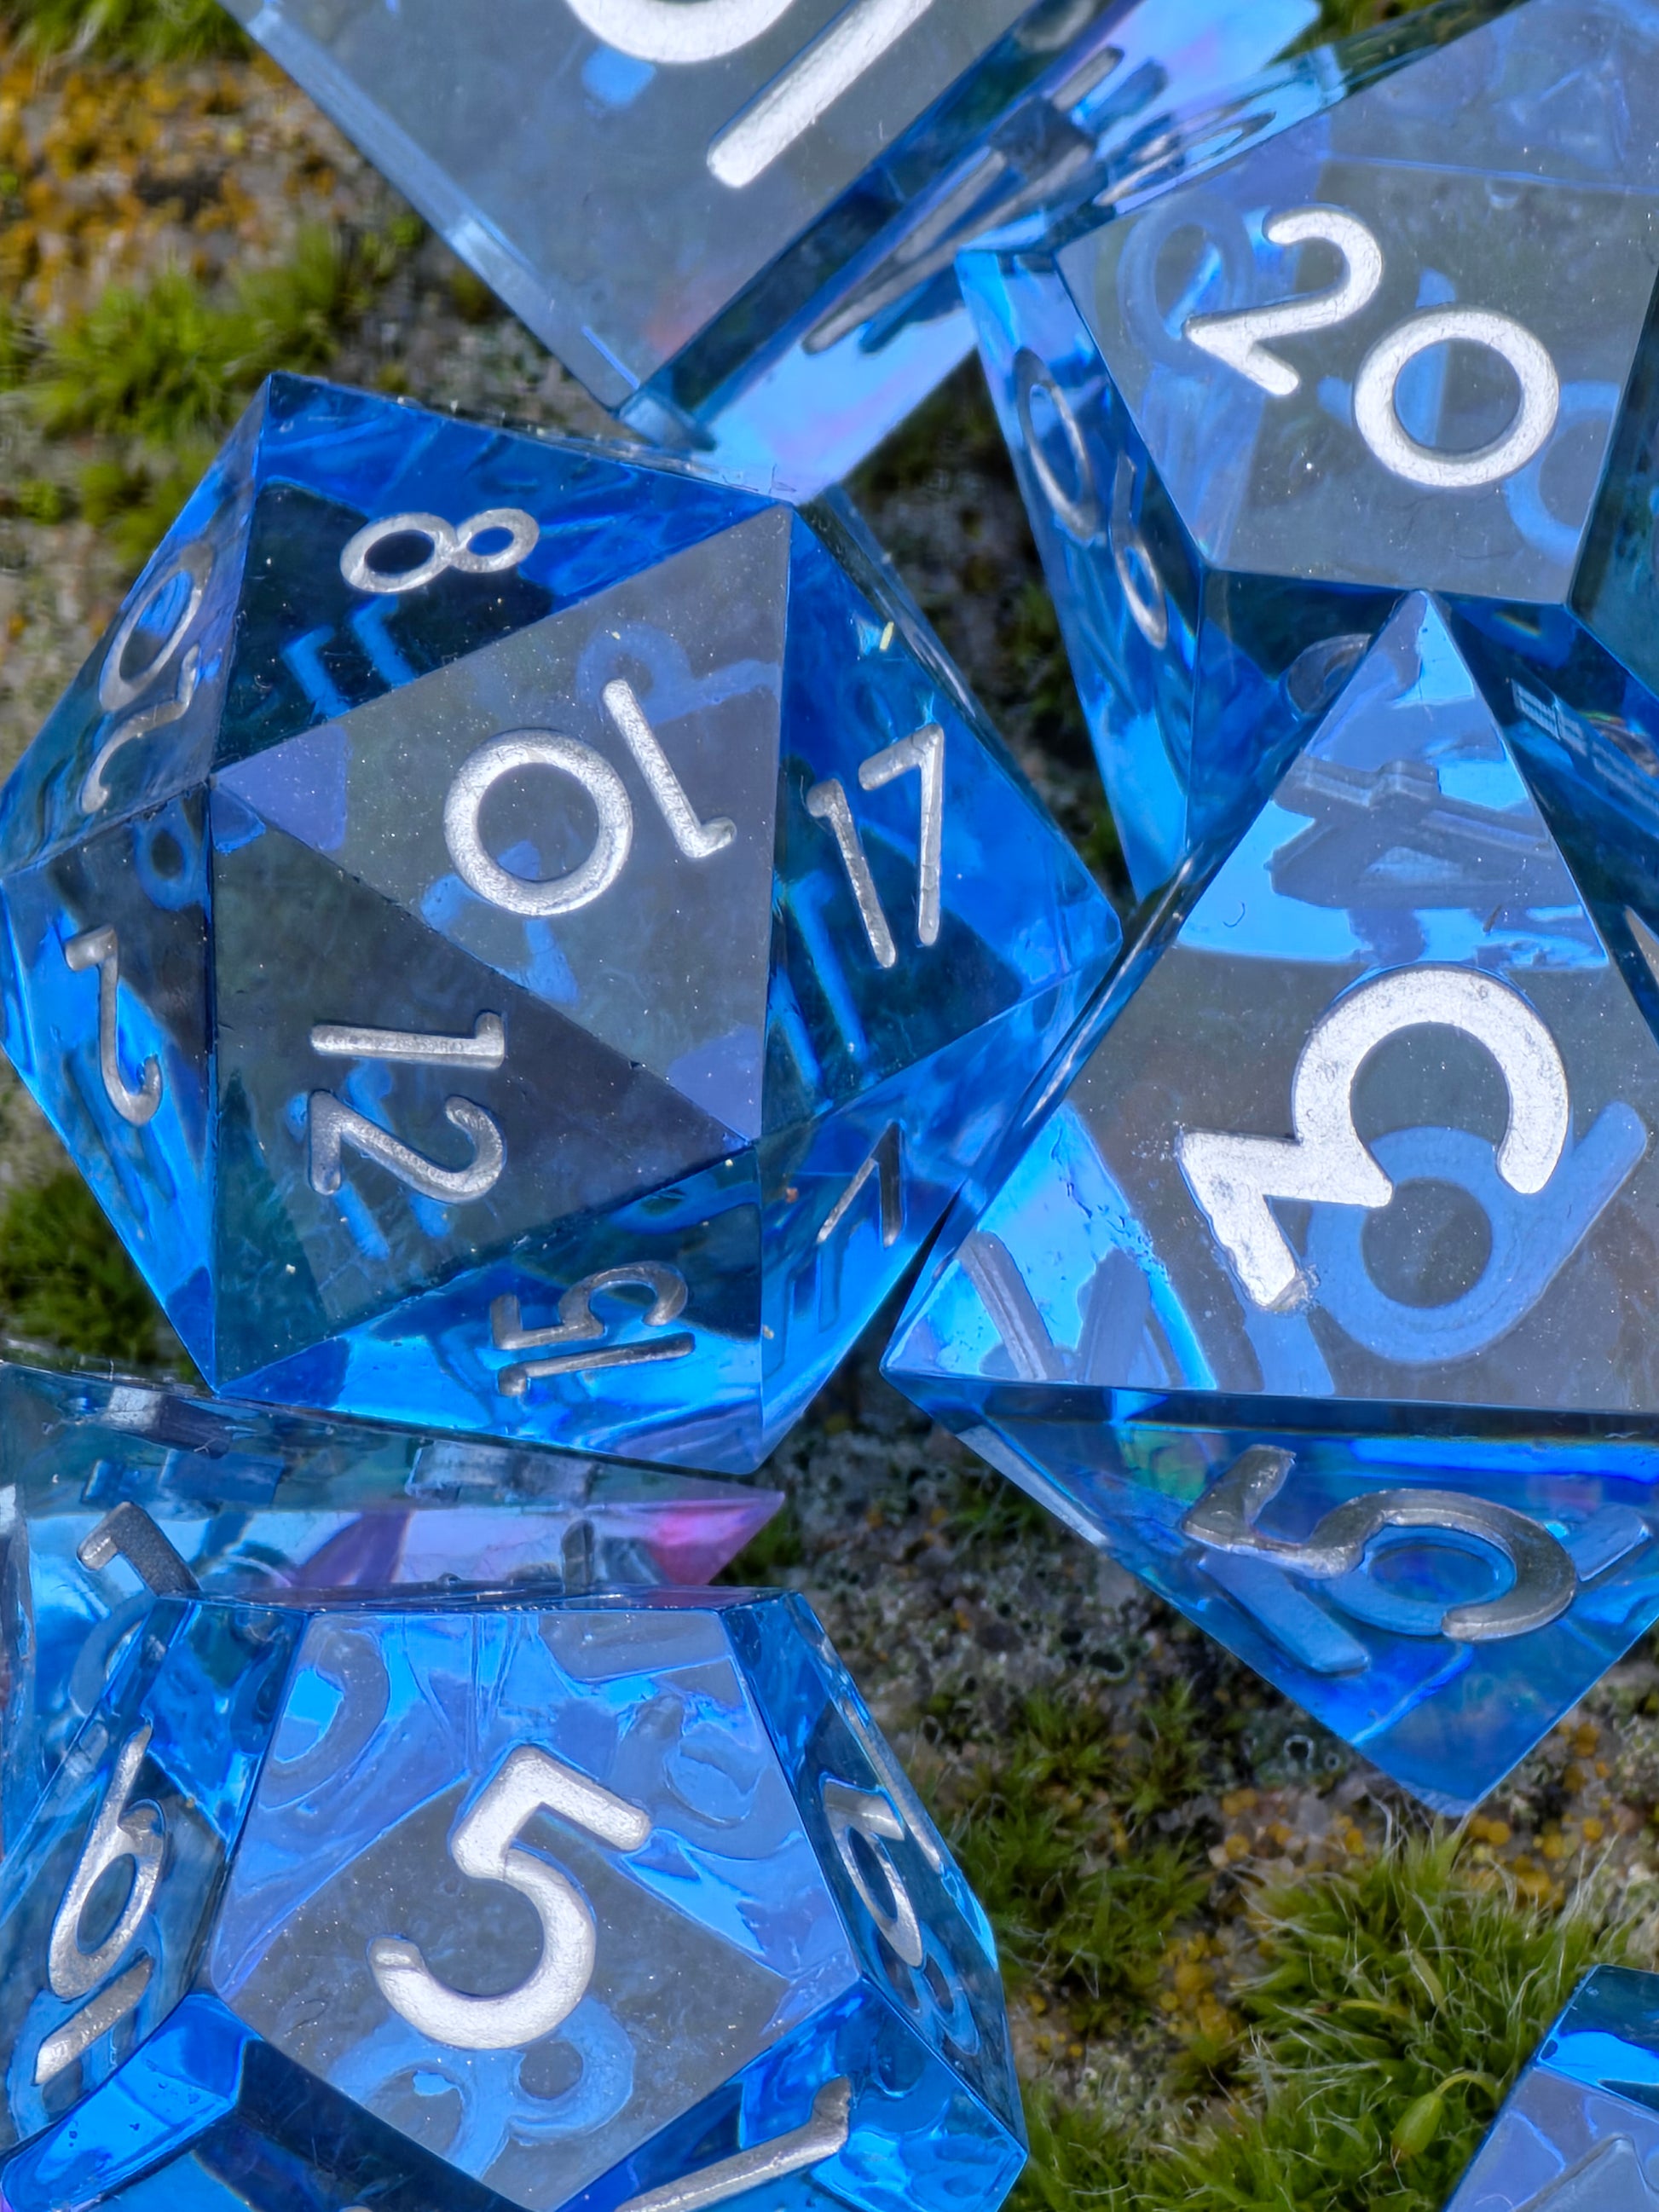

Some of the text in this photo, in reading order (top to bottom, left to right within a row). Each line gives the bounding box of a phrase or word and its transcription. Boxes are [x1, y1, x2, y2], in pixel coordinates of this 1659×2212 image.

[1184, 204, 1559, 487] 20
[341, 509, 539, 592] 8
[444, 679, 737, 917] 10
[806, 722, 945, 968] 17
[309, 1010, 506, 1204] 12
[1176, 963, 1569, 1311] 3
[490, 1260, 696, 1395] 15
[1183, 1442, 1575, 1641] 5
[368, 1745, 650, 2049] 5
